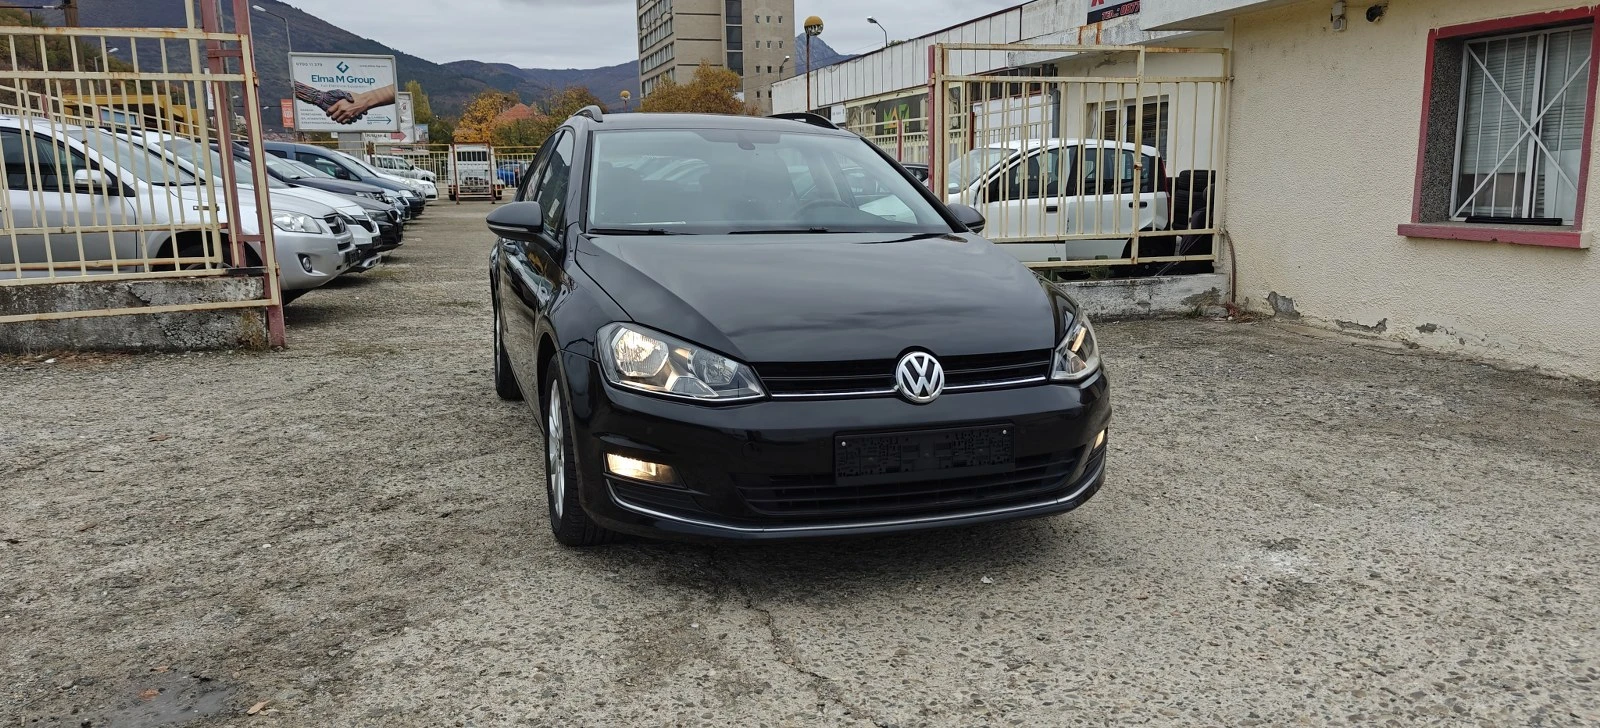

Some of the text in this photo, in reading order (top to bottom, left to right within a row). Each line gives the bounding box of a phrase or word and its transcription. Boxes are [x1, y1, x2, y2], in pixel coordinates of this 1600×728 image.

[311, 74, 376, 86] Elma M Group
[898, 353, 943, 401] VW
